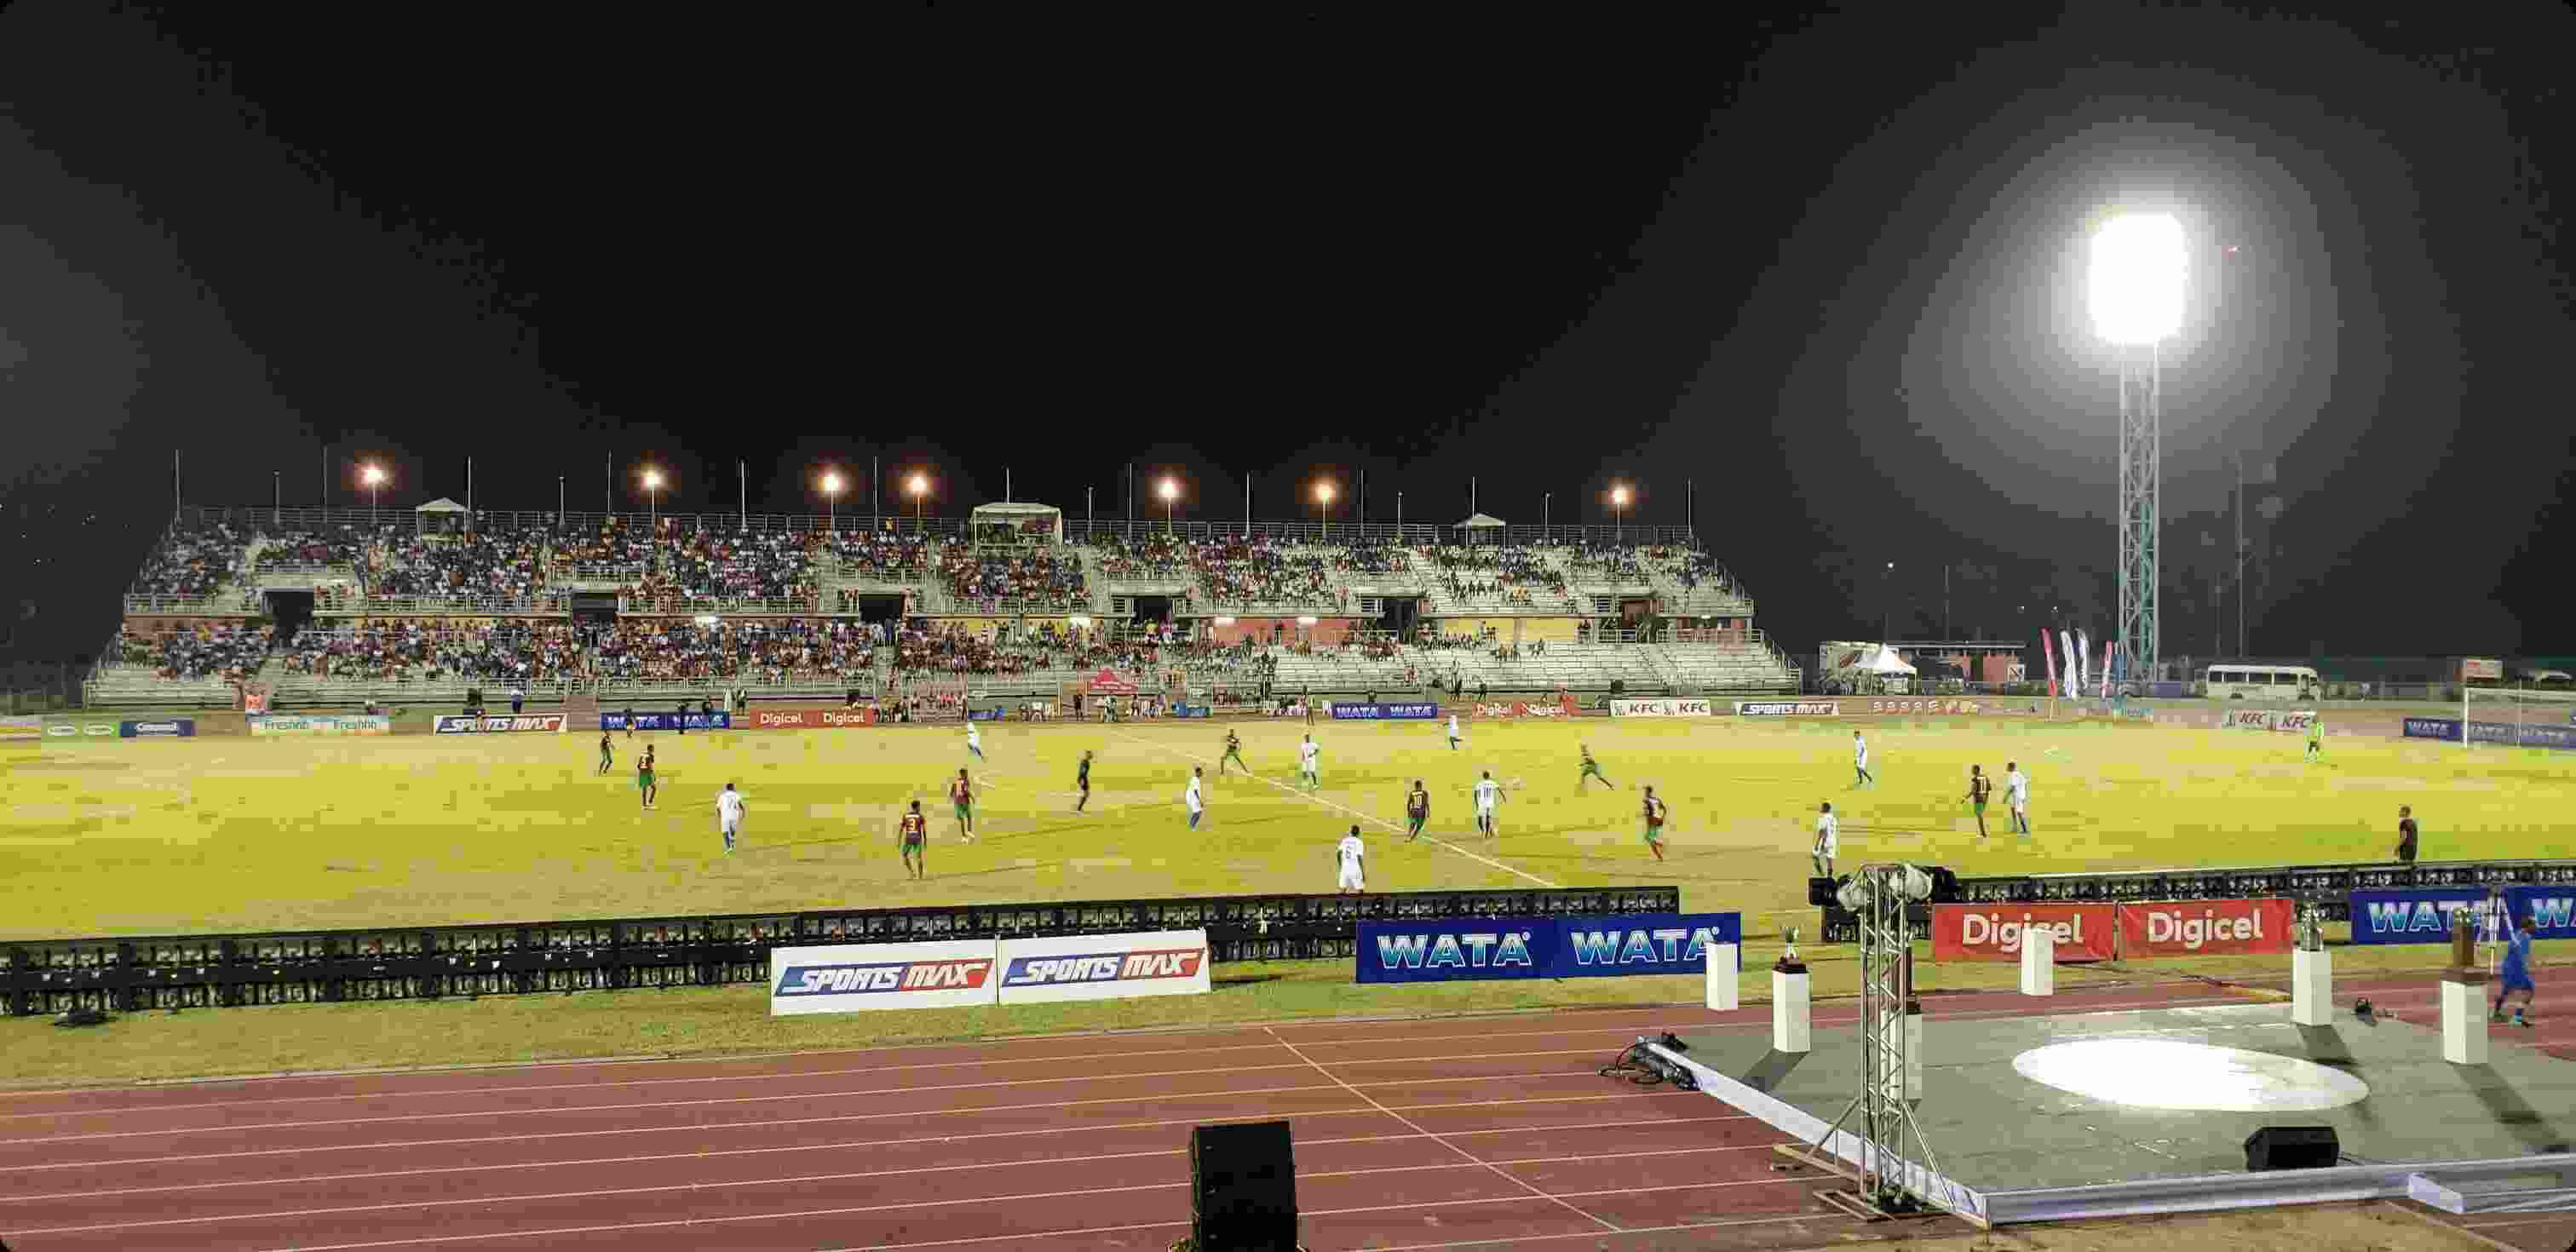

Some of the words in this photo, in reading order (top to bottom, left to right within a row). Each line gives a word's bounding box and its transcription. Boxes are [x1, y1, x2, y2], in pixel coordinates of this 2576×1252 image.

[1337, 706, 1378, 718] WATA
[1390, 705, 1432, 716] WATA
[1630, 704, 1658, 714] KFC
[1679, 703, 1708, 713] KFC
[607, 715, 660, 729] WTA
[760, 712, 803, 727] Digicel
[823, 711, 865, 727] Digicel
[1963, 912, 2085, 953] Digiel
[2148, 909, 2263, 949] Digicel
